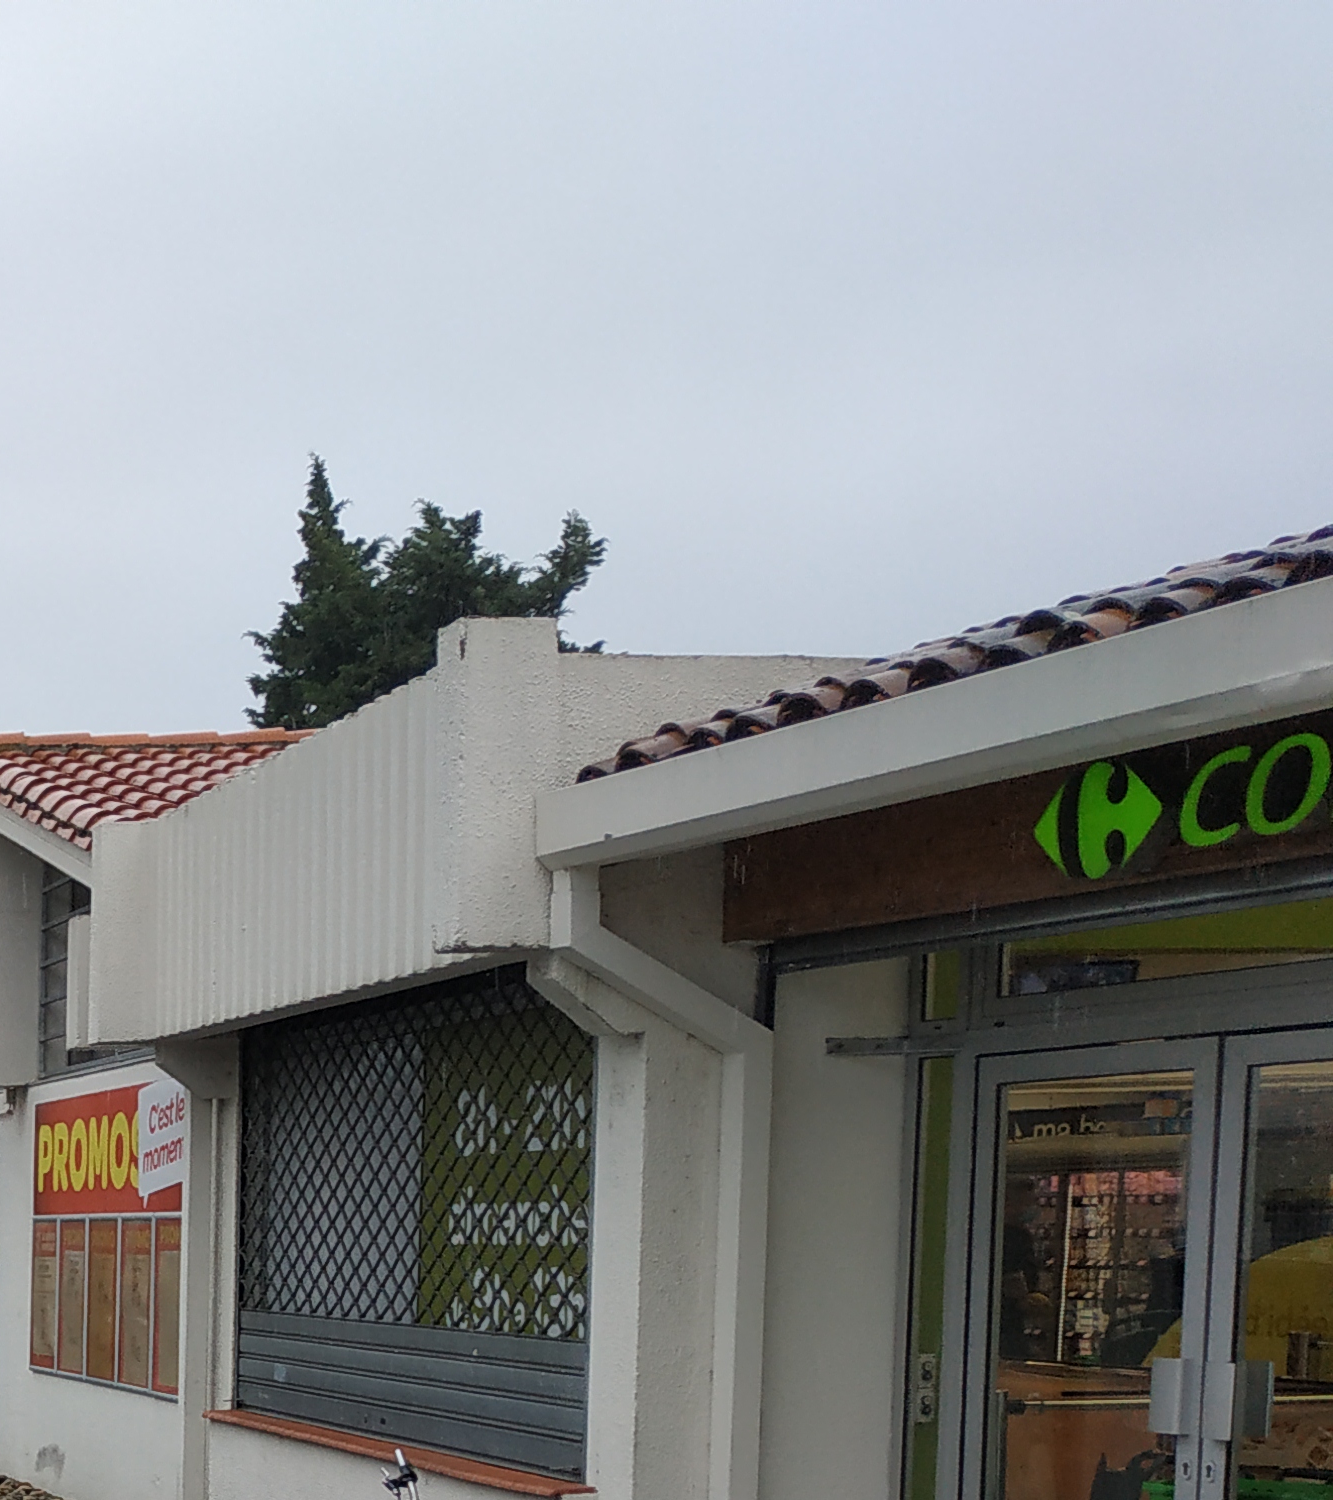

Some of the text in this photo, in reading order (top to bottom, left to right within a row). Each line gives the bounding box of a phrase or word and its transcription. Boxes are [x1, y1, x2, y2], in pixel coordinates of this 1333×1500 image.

[1179, 732, 1333, 847] co
[148, 1091, 185, 1135] C'est le
[142, 1136, 185, 1174] momen
